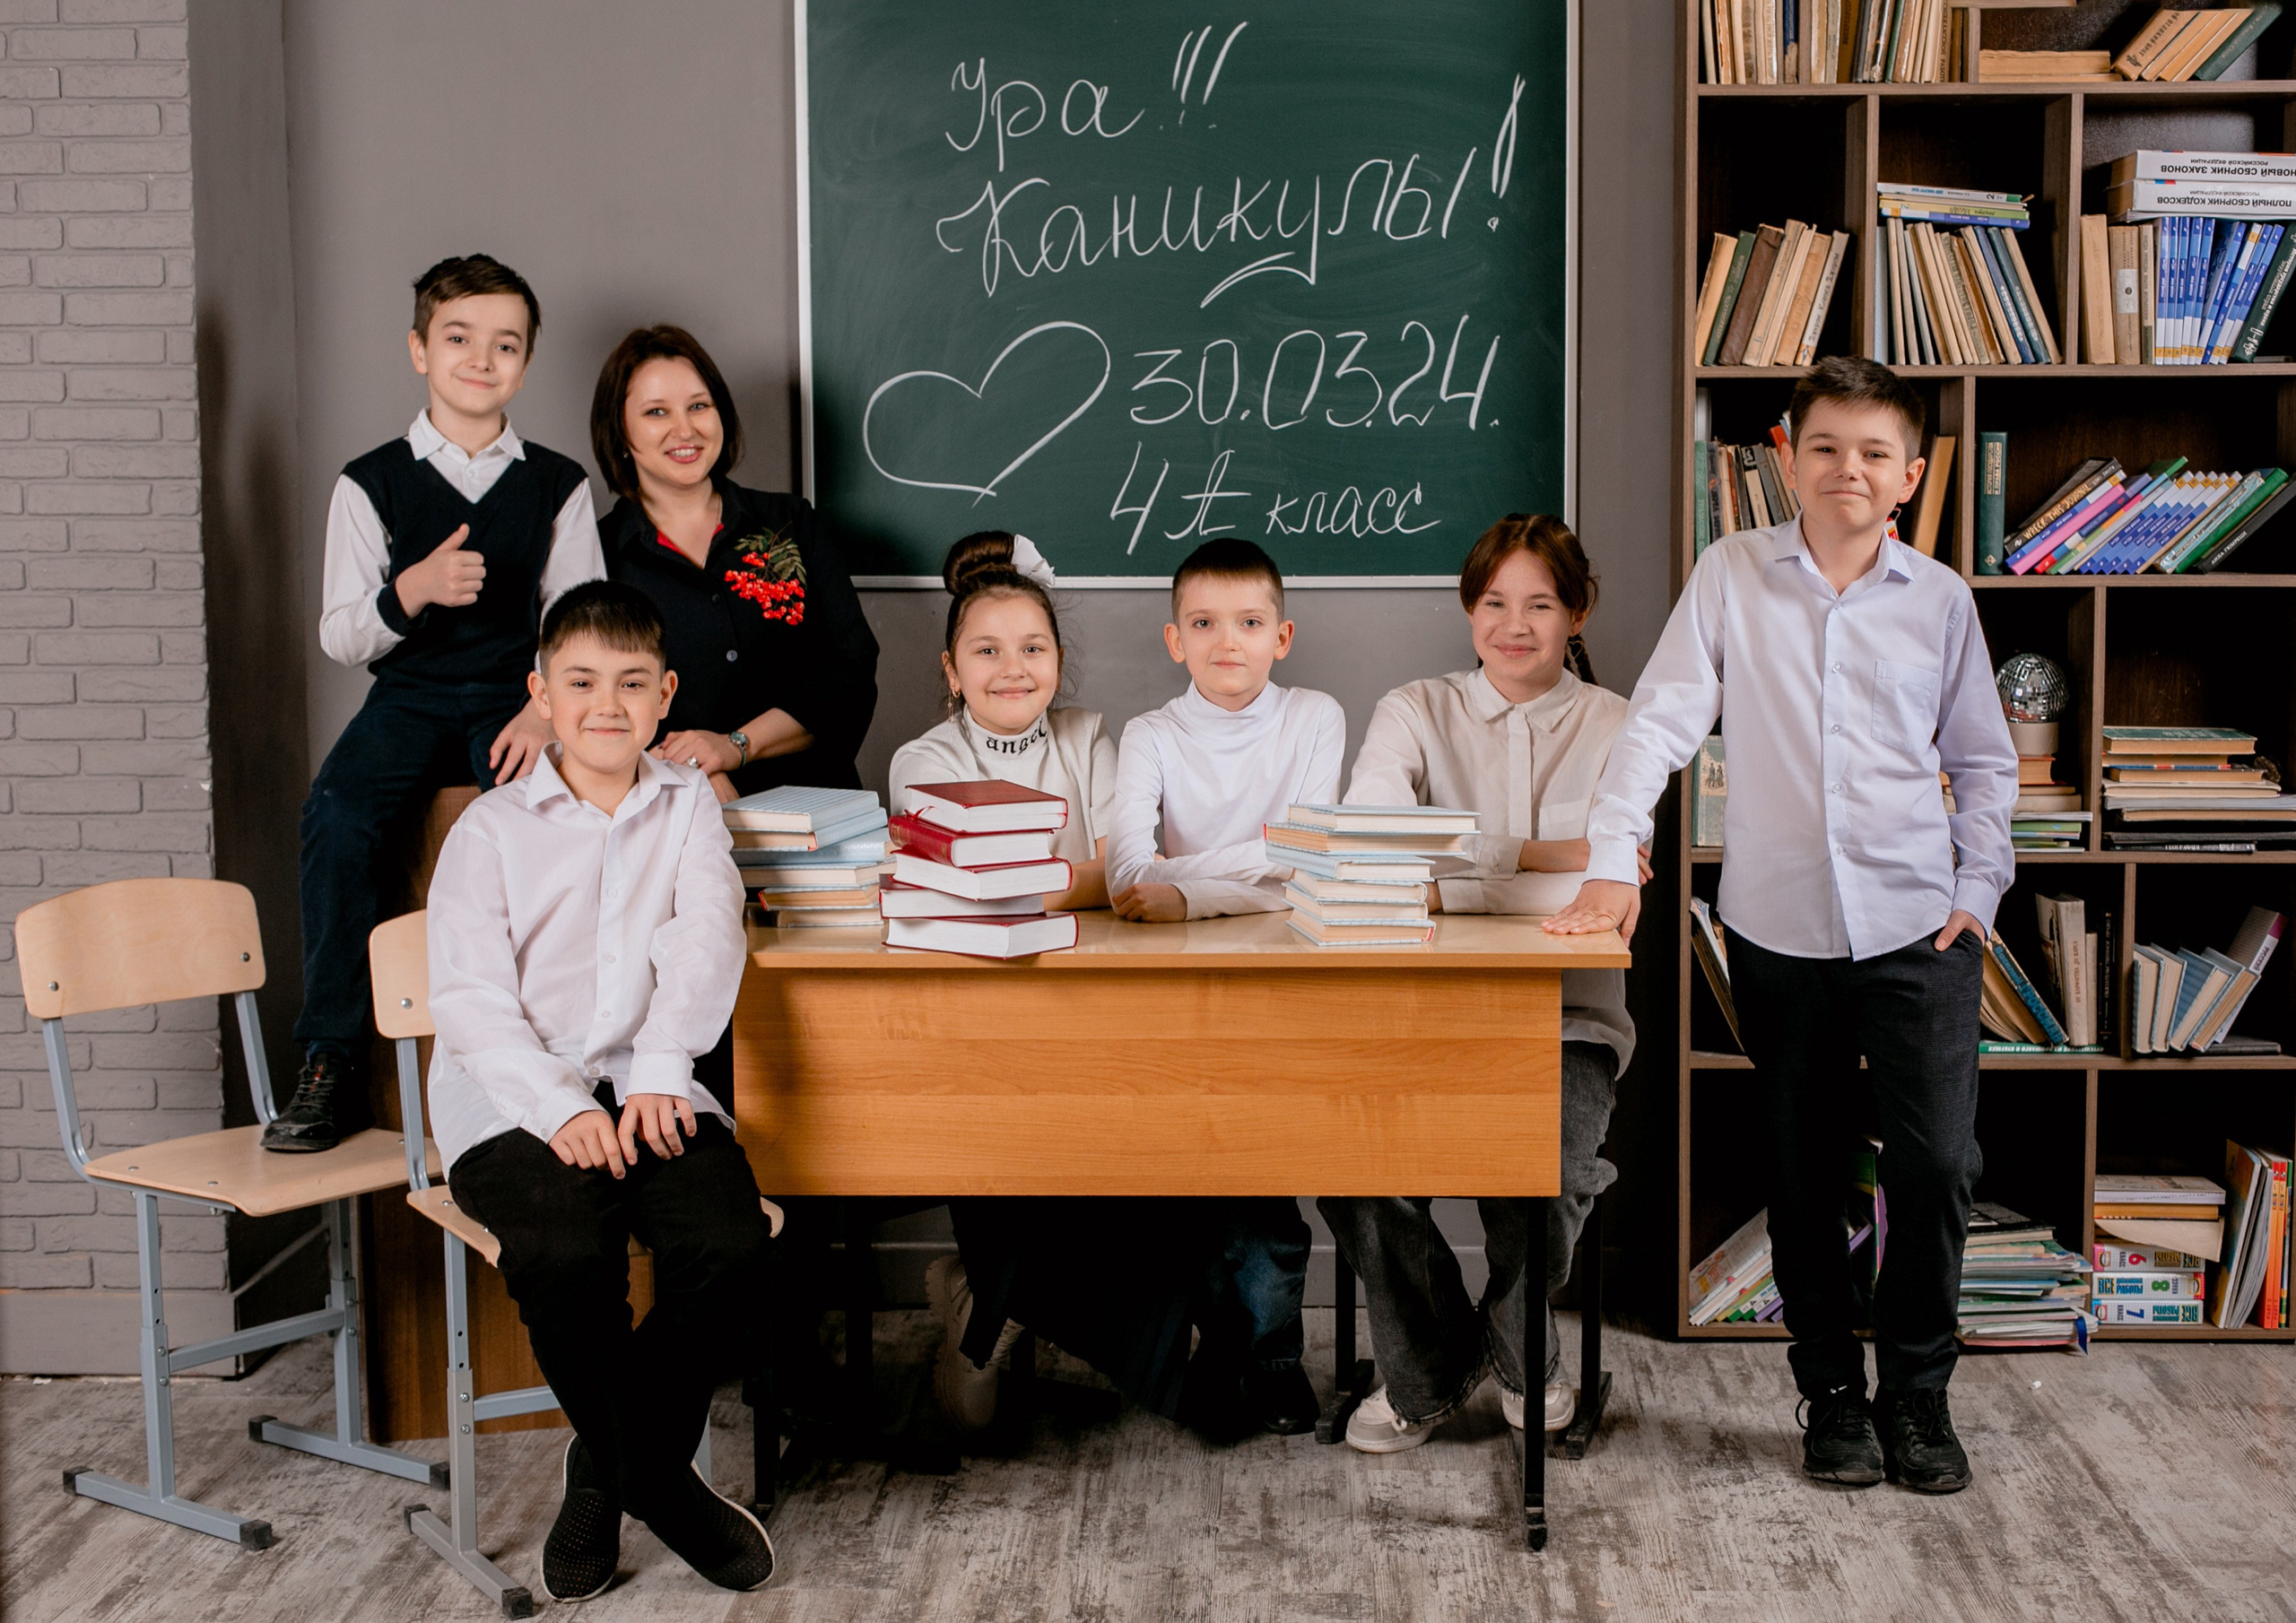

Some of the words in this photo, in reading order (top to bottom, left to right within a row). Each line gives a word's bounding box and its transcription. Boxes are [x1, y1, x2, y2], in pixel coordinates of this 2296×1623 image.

[2151, 19, 2174, 46] ВЕЛИКИЙ
[2139, 43, 2152, 57] БРАТ
[2161, 165, 2208, 174] ЗАКОНОВ
[2211, 166, 2258, 176] СБОРНИК
[2260, 167, 2296, 178] НОВЫЙ
[936, 74, 1526, 308] Каникулы!
[2157, 196, 2206, 205] КОДЕКСОВ
[2207, 197, 2250, 206] СБОРНИК
[2252, 199, 2292, 208] ПОЛНЫЙ
[2268, 271, 2287, 306] государства
[2259, 308, 2271, 326] права
[1110, 442, 1169, 555] 4
[1266, 482, 1440, 538] класс
[2023, 516, 2048, 539] WRECK
[2048, 504, 2066, 522] THIS
[2064, 482, 2092, 511] JOURNAL
[987, 716, 1048, 755] angel
[1995, 945, 2024, 985] Василий
[2018, 983, 2063, 1044] ГРОССМАН
[2128, 1254, 2146, 1265] 6
[2155, 1252, 2181, 1261] РАБОТЫ
[2183, 1252, 2200, 1269] ВСЕ
[2098, 1278, 2114, 1294] ВСЕ
[2117, 1285, 2143, 1294] РАБОТЫ
[2152, 1280, 2170, 1291] 8
[2126, 1308, 2144, 1318] 7
[2152, 1306, 2179, 1315] РАБОТЫ
[2181, 1306, 2199, 1323] ВСЕ
